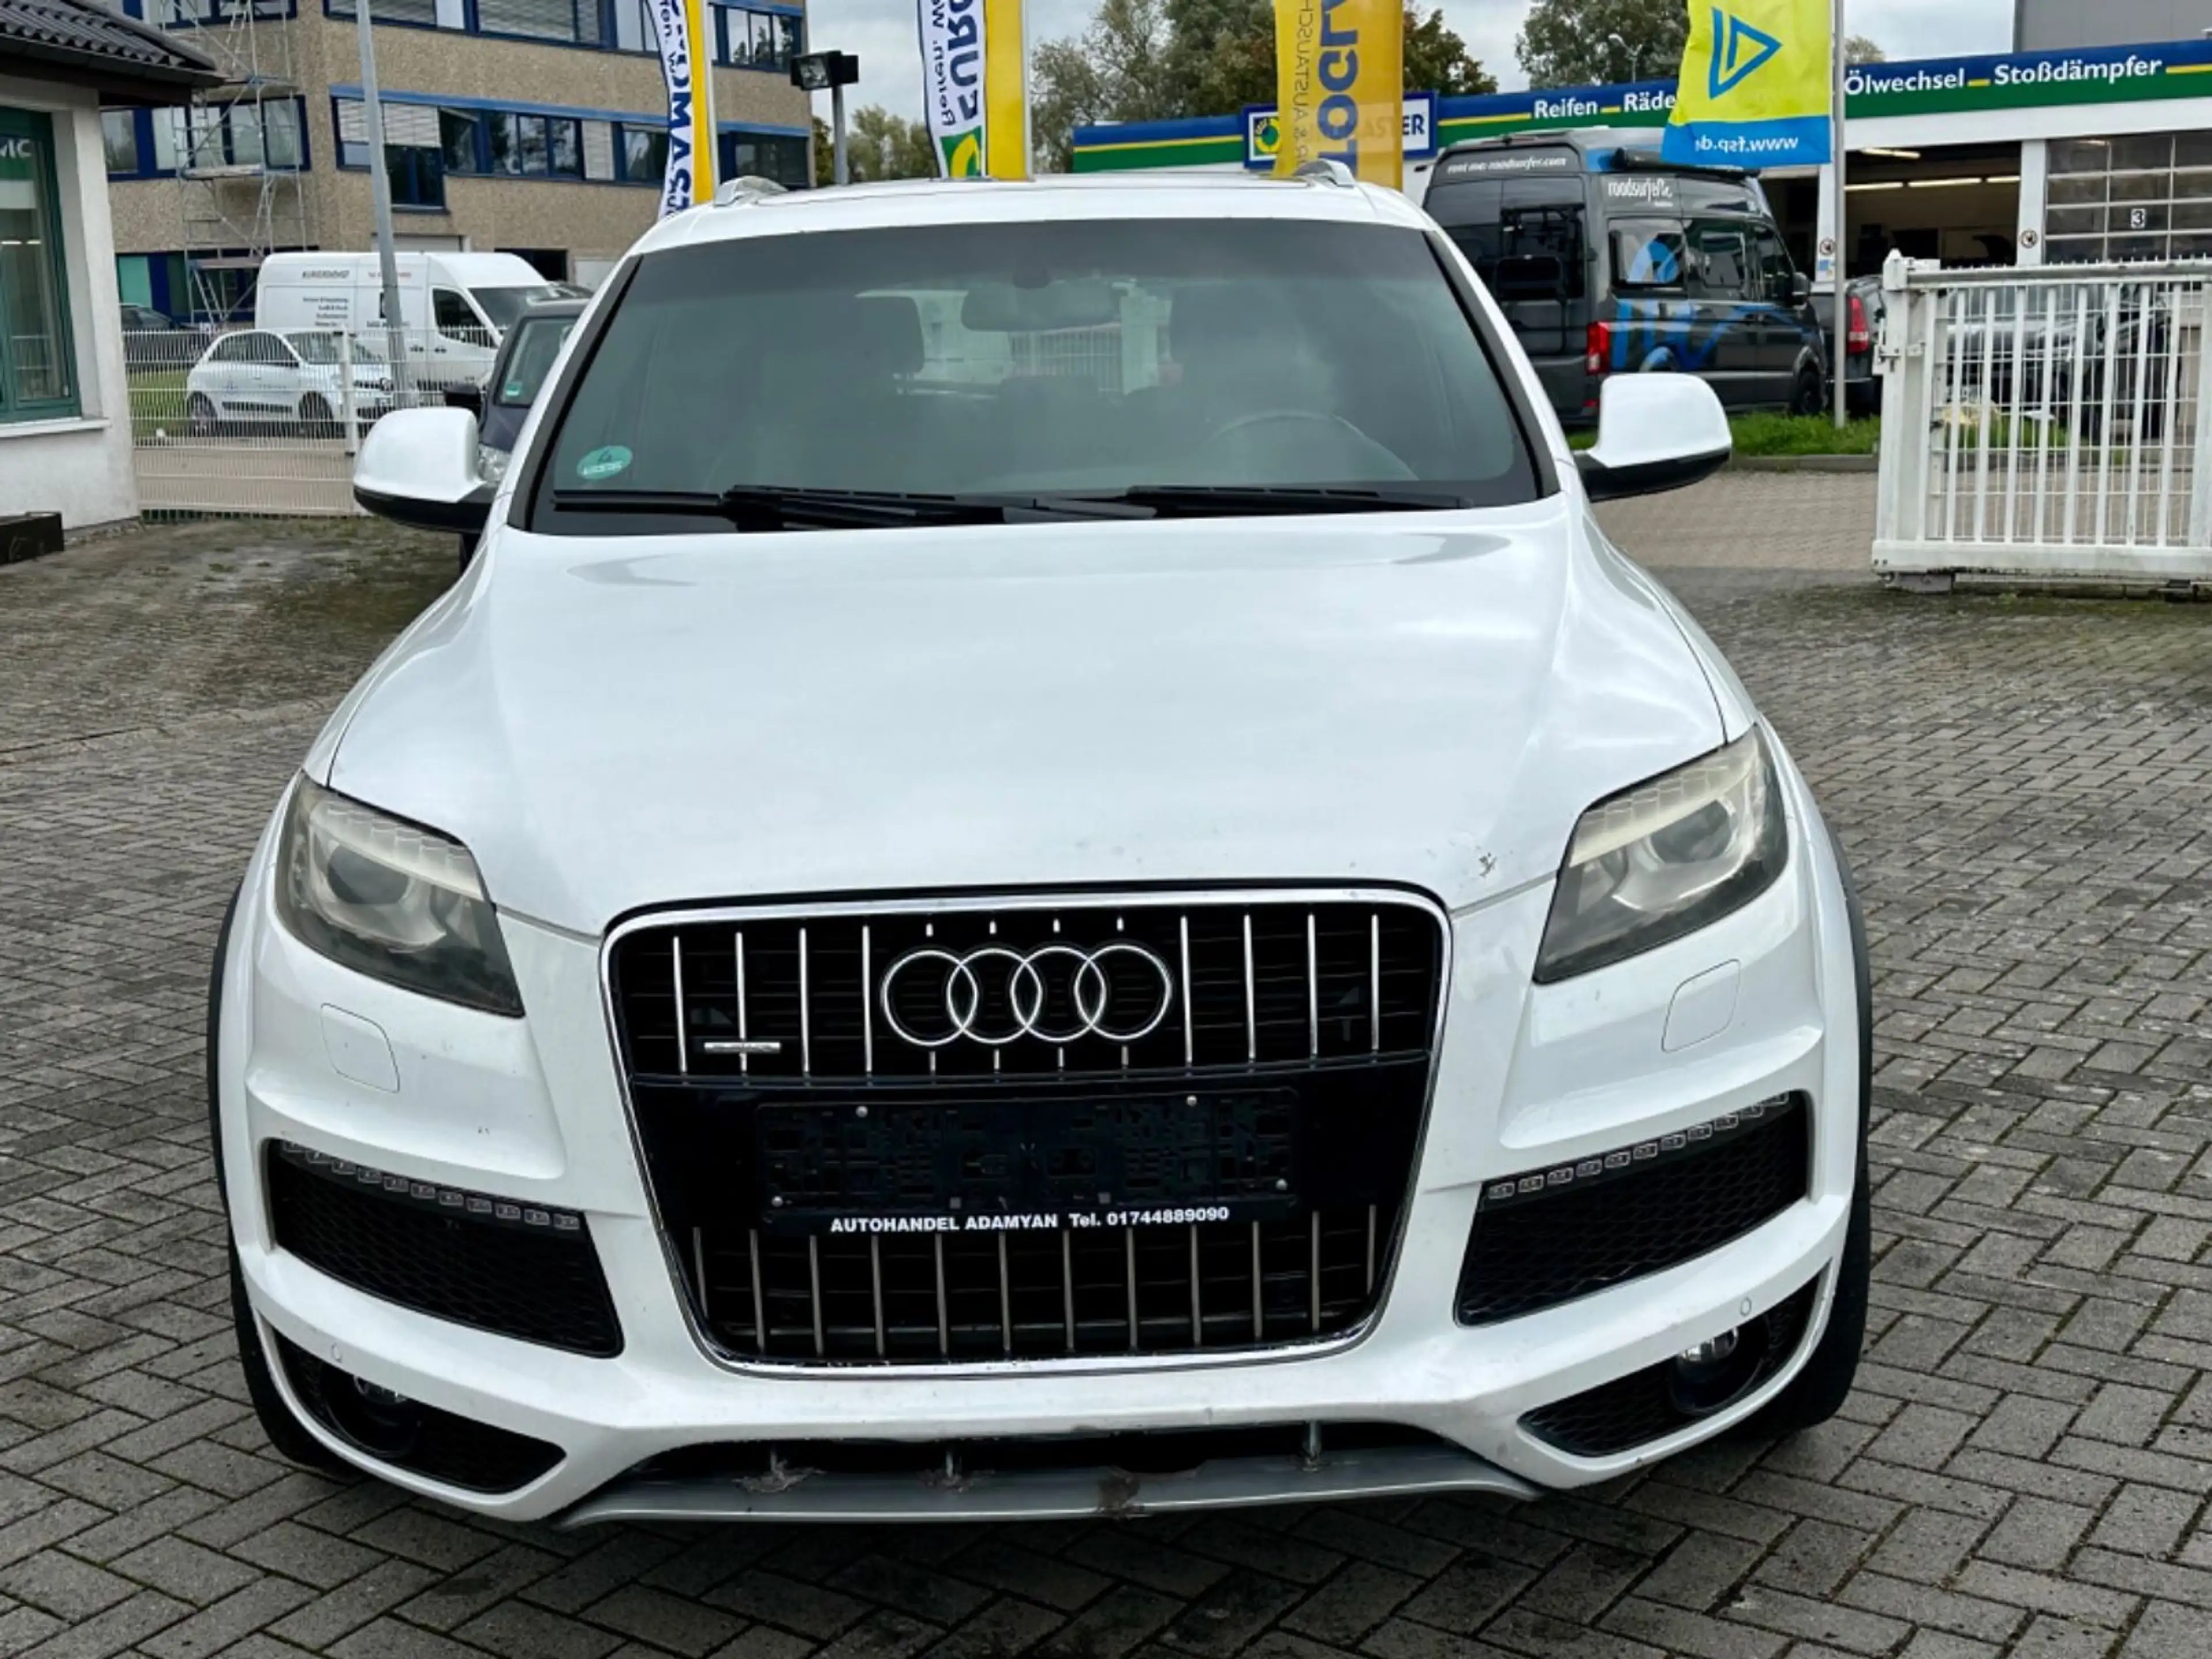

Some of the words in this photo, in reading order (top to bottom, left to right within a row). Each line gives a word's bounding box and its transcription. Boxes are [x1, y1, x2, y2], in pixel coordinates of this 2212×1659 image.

[1845, 68, 1965, 96] Ölwechsel
[1994, 55, 2162, 85] Stoßdämpfer
[1533, 97, 1598, 119] Reifen
[2133, 210, 2143, 227] 3
[830, 1215, 960, 1233] AUTOHANDEL
[965, 1214, 1058, 1230] ADAMYAN
[1069, 1213, 1101, 1228] Tel.
[1106, 1206, 1229, 1226] 01744889090
